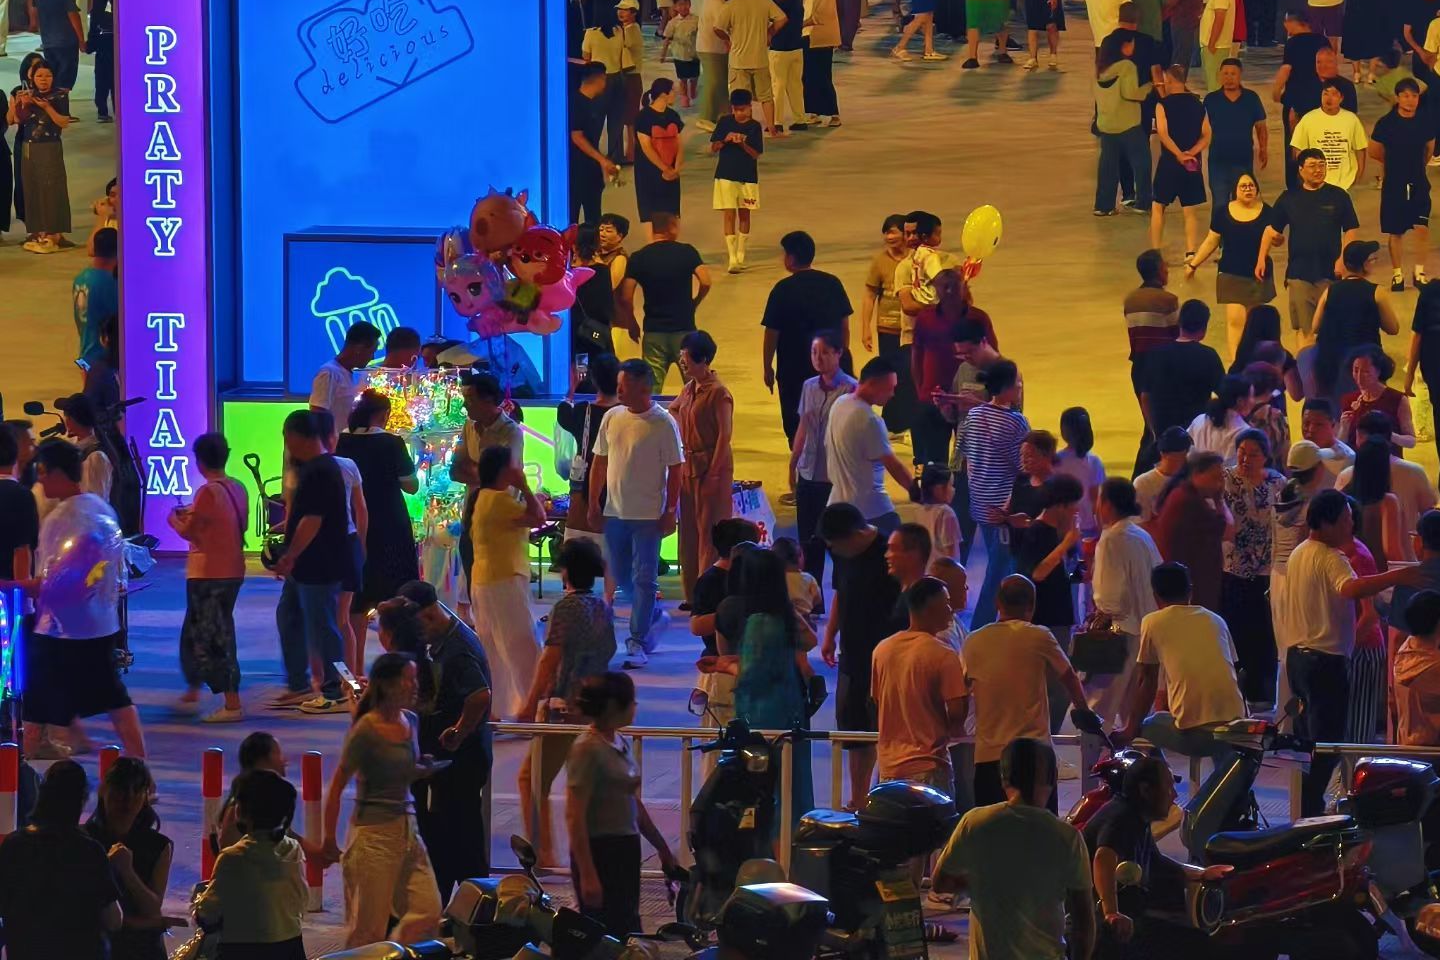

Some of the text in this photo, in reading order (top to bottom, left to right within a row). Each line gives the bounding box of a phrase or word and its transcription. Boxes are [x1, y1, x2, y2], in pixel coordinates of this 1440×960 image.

[321, 24, 449, 95] delicious
[144, 25, 193, 497] PRATY TIAM
